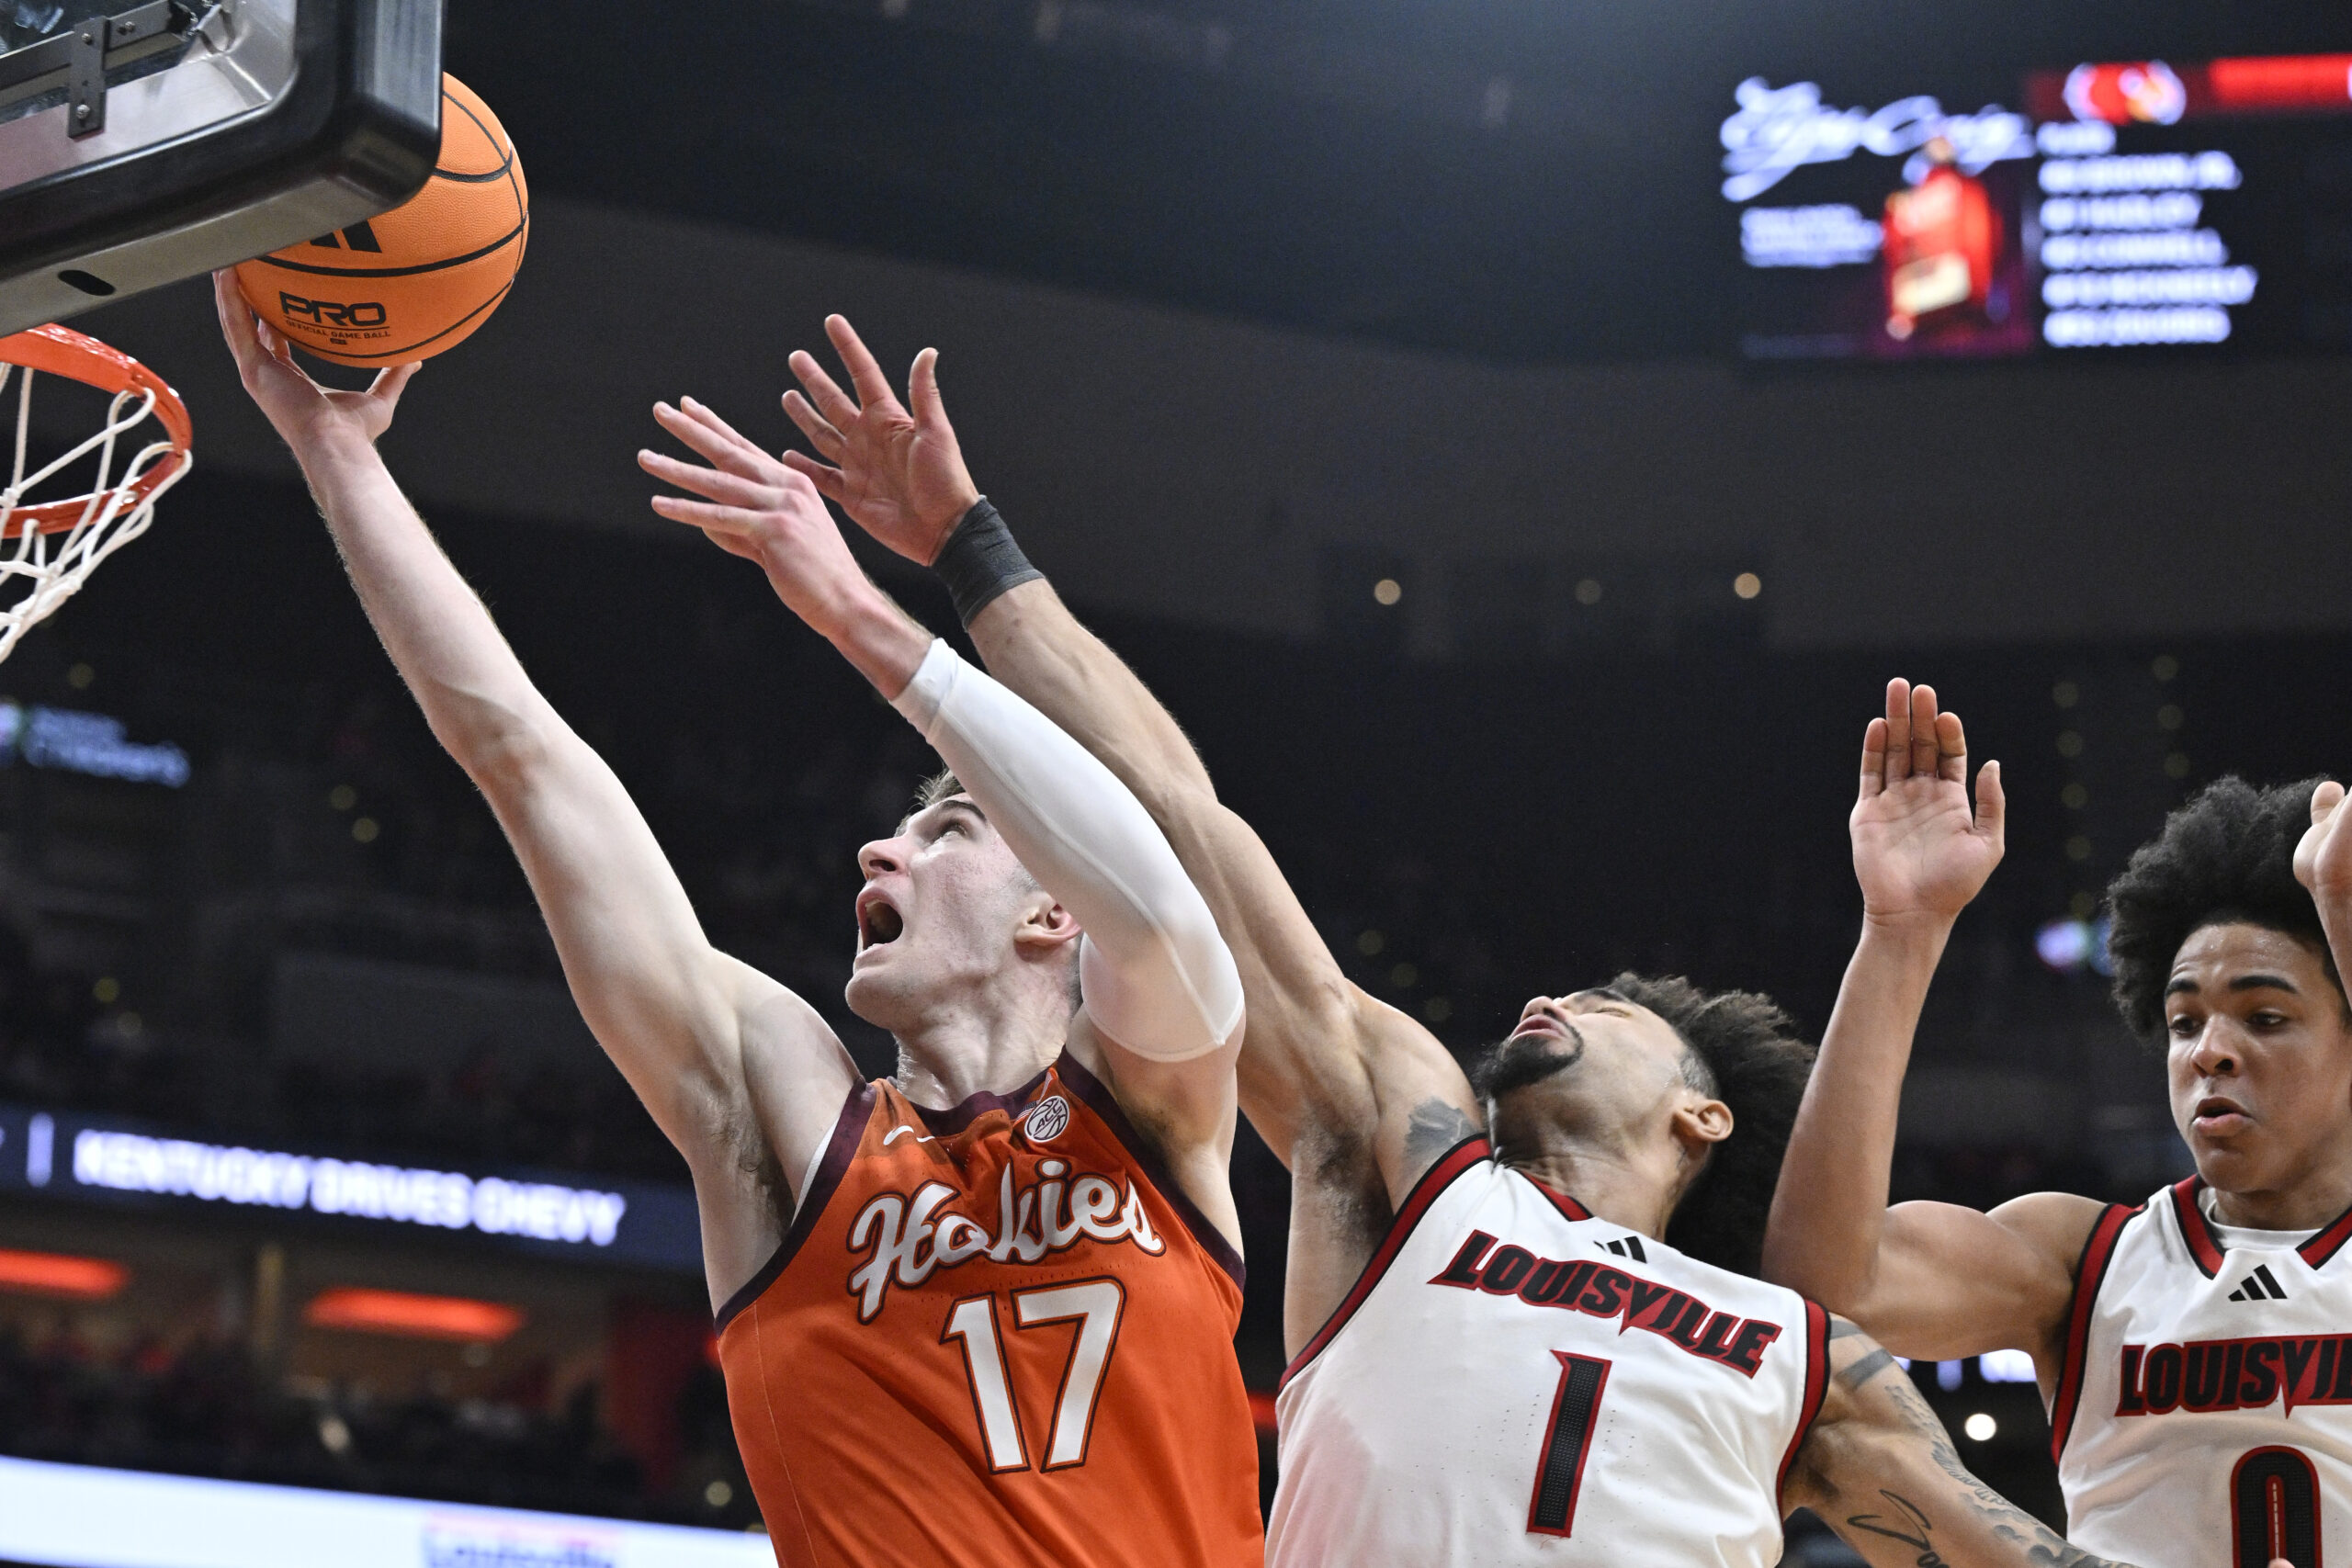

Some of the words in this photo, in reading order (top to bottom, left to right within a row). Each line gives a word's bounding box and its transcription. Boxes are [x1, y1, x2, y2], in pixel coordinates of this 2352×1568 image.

[278, 290, 386, 327] PRO
[285, 319, 328, 336] OFFICIAL
[331, 331, 362, 339] GAME
[363, 330, 391, 339] BALL
[74, 1130, 311, 1207] KENTUCKY
[473, 1178, 624, 1245] CHEVY
[846, 1157, 1166, 1325] Hokies
[1426, 1229, 1783, 1380] LOUISVILLE
[939, 1275, 1126, 1475] 17
[1526, 1349, 1613, 1538] 1
[2230, 1445, 2323, 1568] 0
